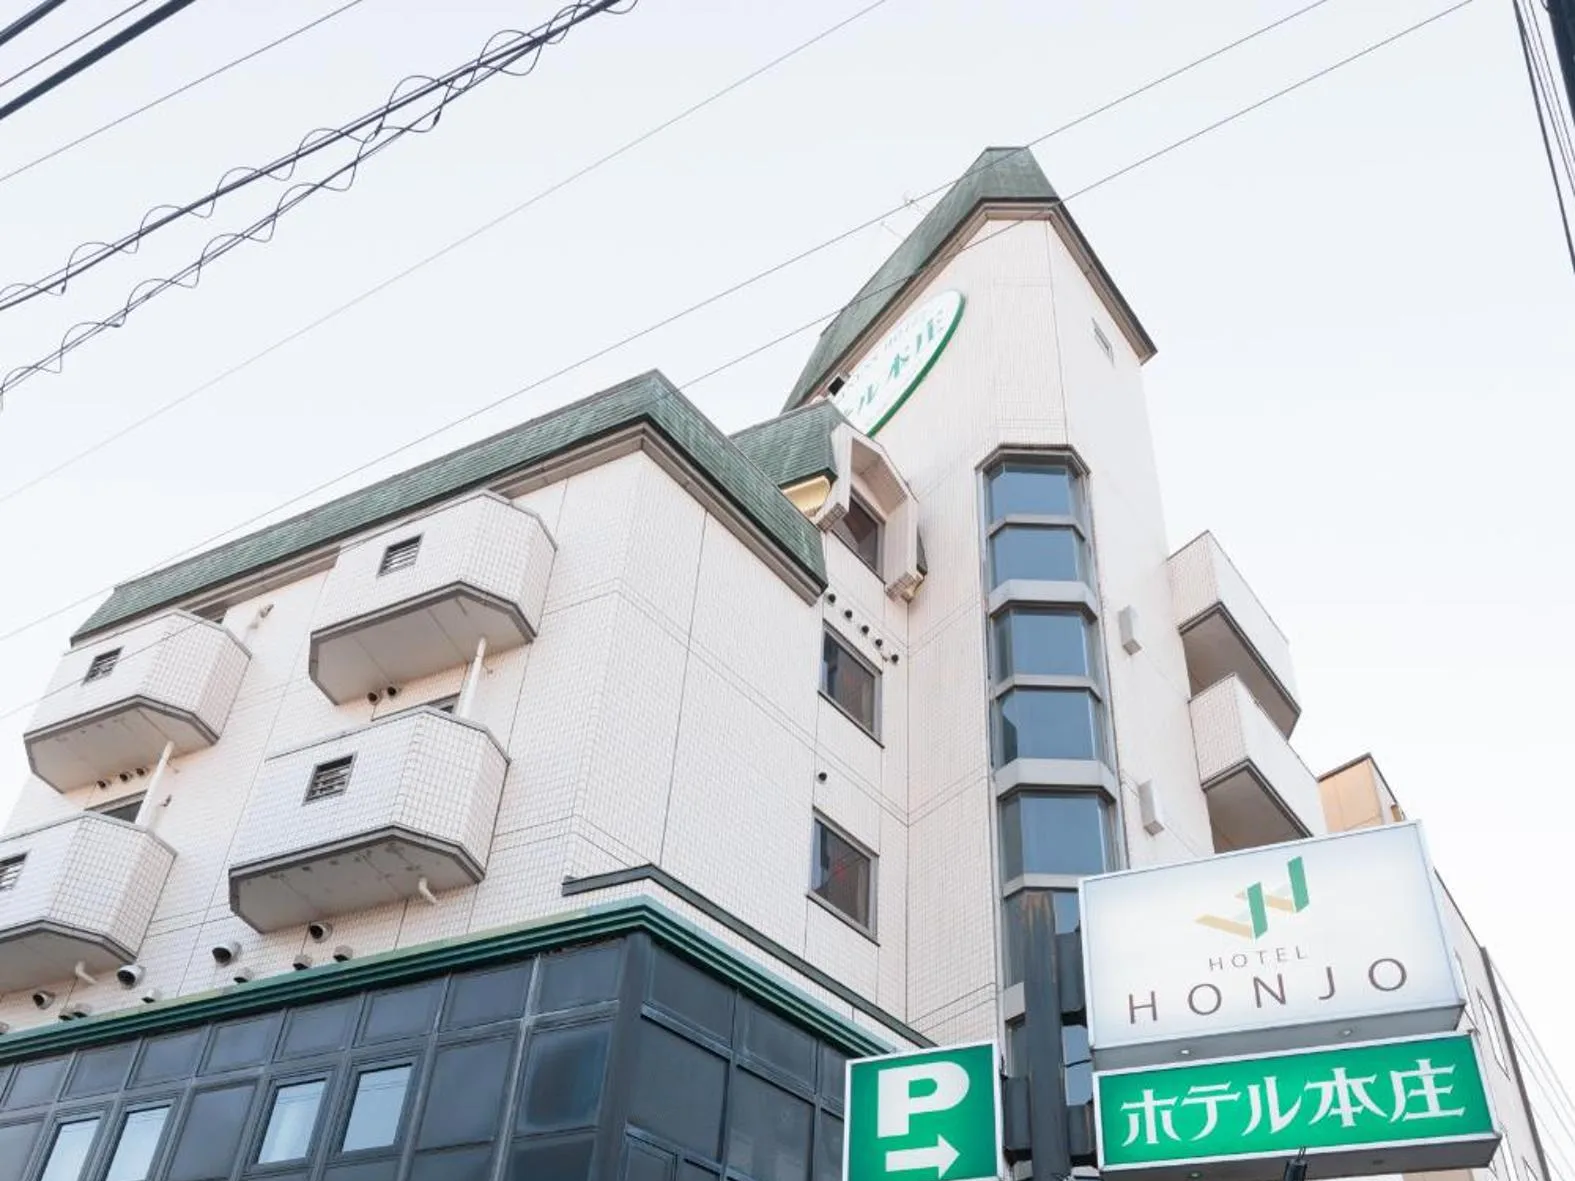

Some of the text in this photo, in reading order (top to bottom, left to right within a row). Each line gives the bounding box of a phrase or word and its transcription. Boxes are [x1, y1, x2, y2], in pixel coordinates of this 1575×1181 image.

[1128, 957, 1408, 1025] HONJO
[1208, 945, 1308, 971] HOTEL
[877, 1061, 970, 1138] P
[1120, 1058, 1466, 1148] ホテル本庄
